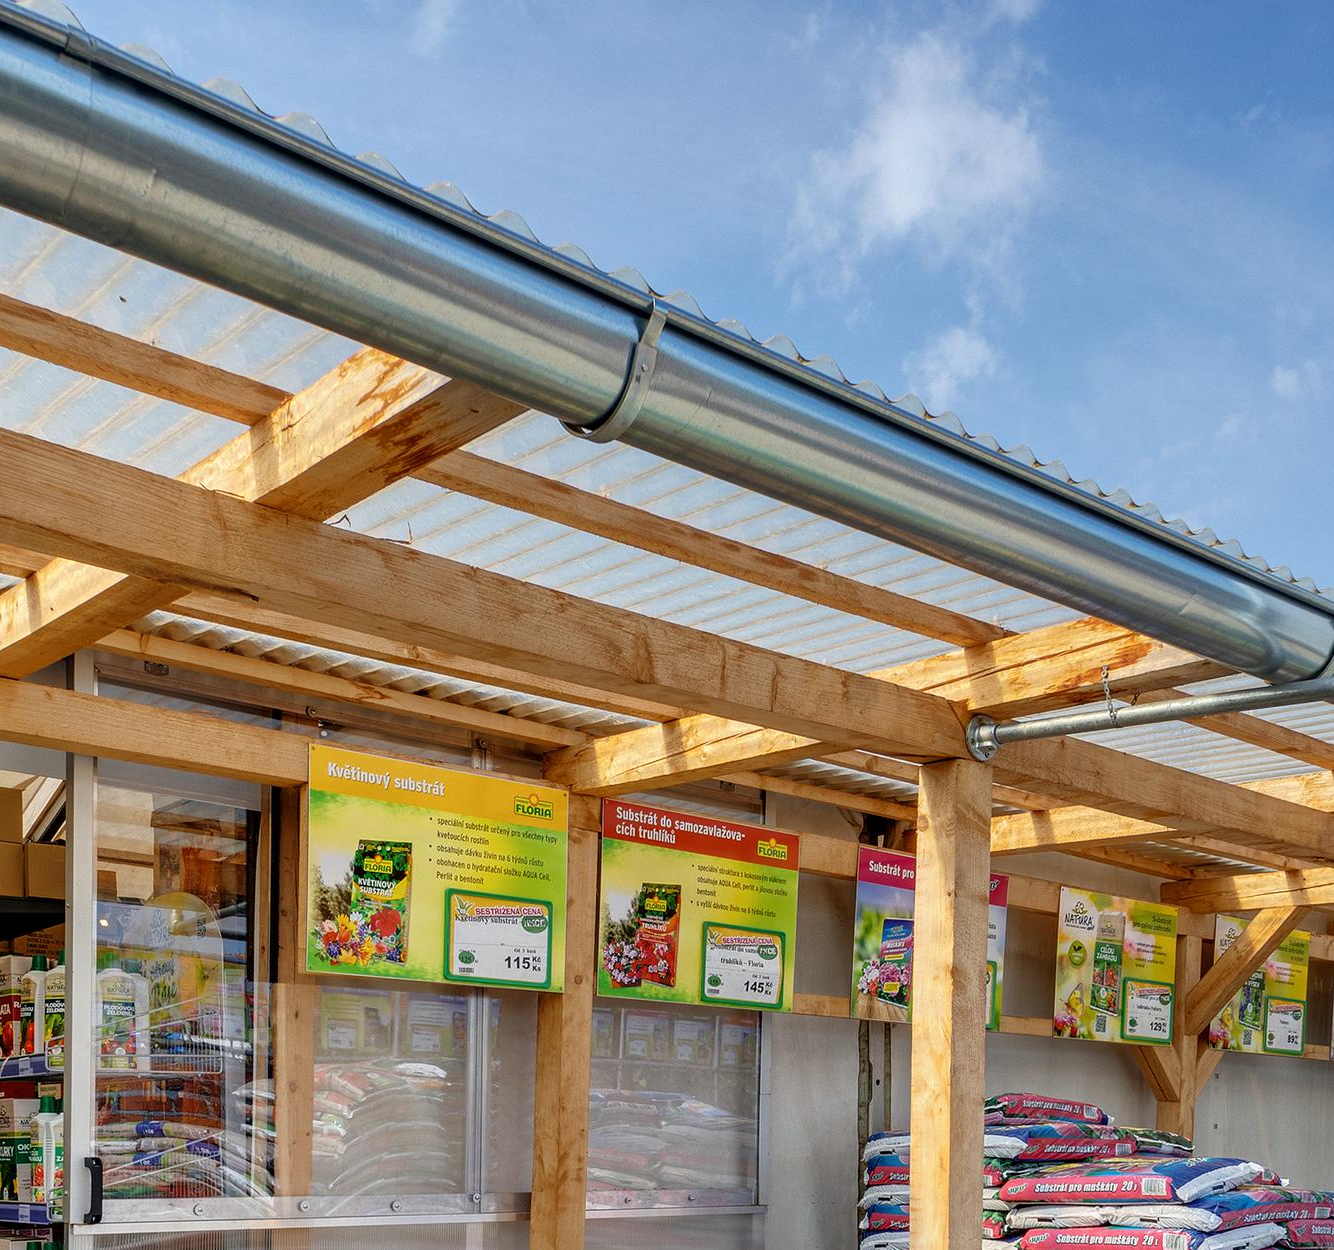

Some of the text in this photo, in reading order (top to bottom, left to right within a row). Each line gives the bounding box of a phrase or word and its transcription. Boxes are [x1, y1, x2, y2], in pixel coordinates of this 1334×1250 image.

[327, 762, 445, 797] Květinový substrát
[515, 804, 552, 818] FLORIA
[617, 807, 745, 841] Substrát do samozavlažova-
[437, 817, 464, 828] speciální
[465, 821, 489, 833] substrát
[491, 825, 510, 836] určený
[522, 830, 544, 842] všechny
[545, 835, 557, 844] typy
[616, 823, 676, 844] cích truhlíků
[437, 830, 489, 845] kvetoucích rostlin
[437, 845, 463, 856] obsahuje
[465, 848, 482, 858] dávku
[483, 850, 497, 860] živin
[512, 855, 527, 866] týdnů
[528, 859, 543, 867] růstu
[758, 847, 786, 859] FLORIA
[364, 863, 391, 873] FLORIA
[437, 859, 465, 869] obohacen
[472, 862, 502, 875] hydratační
[504, 867, 521, 878] složku
[523, 870, 537, 880] AQUA
[869, 860, 914, 879] Substrát pro
[358, 877, 396, 889] KVĚTINOVÝ
[437, 871, 453, 881] Perlit
[459, 875, 484, 885] bentonit
[360, 886, 393, 897] SUBSTRÁT
[522, 908, 542, 916] CENA
[491, 916, 518, 925] substrát
[1065, 914, 1093, 926] NATURA
[504, 957, 530, 970] 115
[744, 981, 764, 993] 145
[1150, 1021, 1162, 1032] 129
[1023, 1100, 1043, 1108] Substrát
[1035, 1181, 1133, 1193] Substrát pro muškáty 20
[1056, 1234, 1154, 1246] Substrát pro muškáty 20
